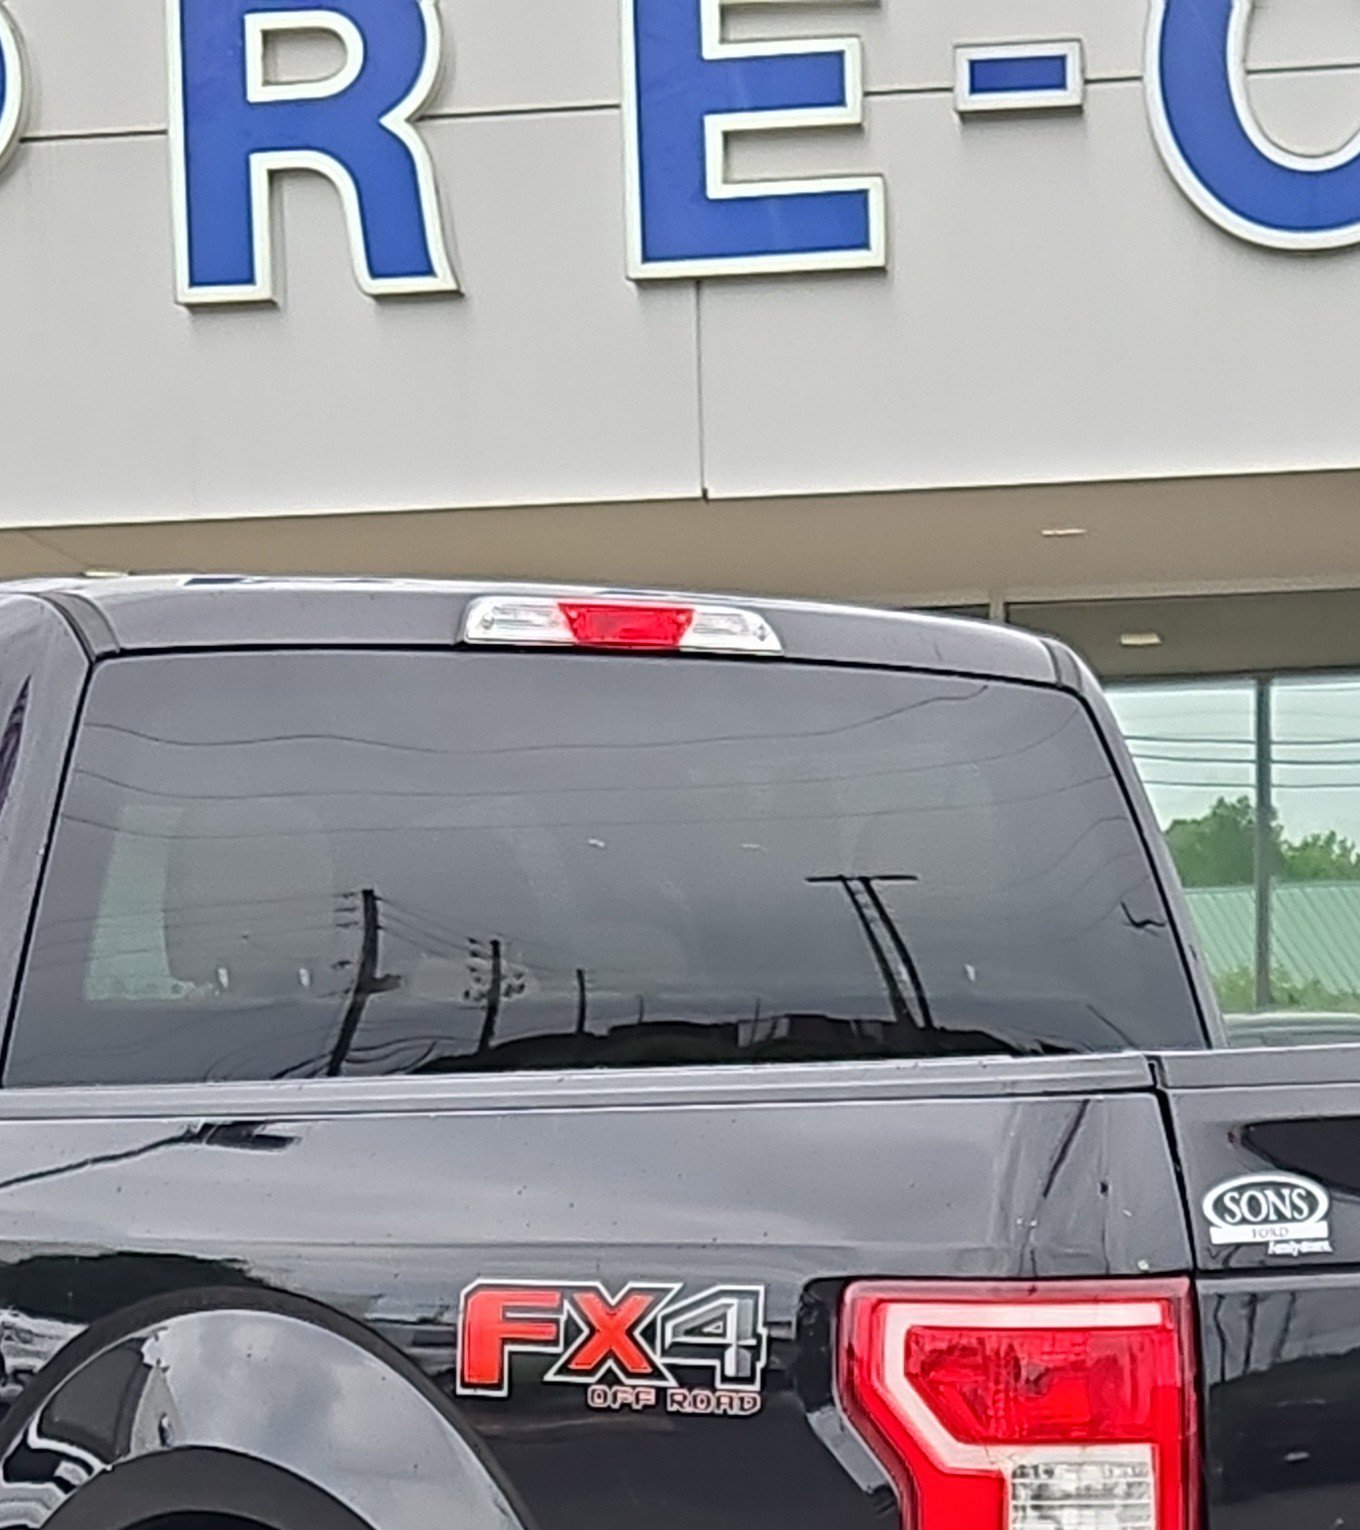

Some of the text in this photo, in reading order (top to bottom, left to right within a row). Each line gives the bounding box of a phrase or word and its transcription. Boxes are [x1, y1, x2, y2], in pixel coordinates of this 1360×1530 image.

[1223, 1187, 1309, 1223] SONS
[1251, 1227, 1289, 1239] FORD
[455, 1278, 768, 1398] FX4
[587, 1385, 761, 1416] OFF ROAD
